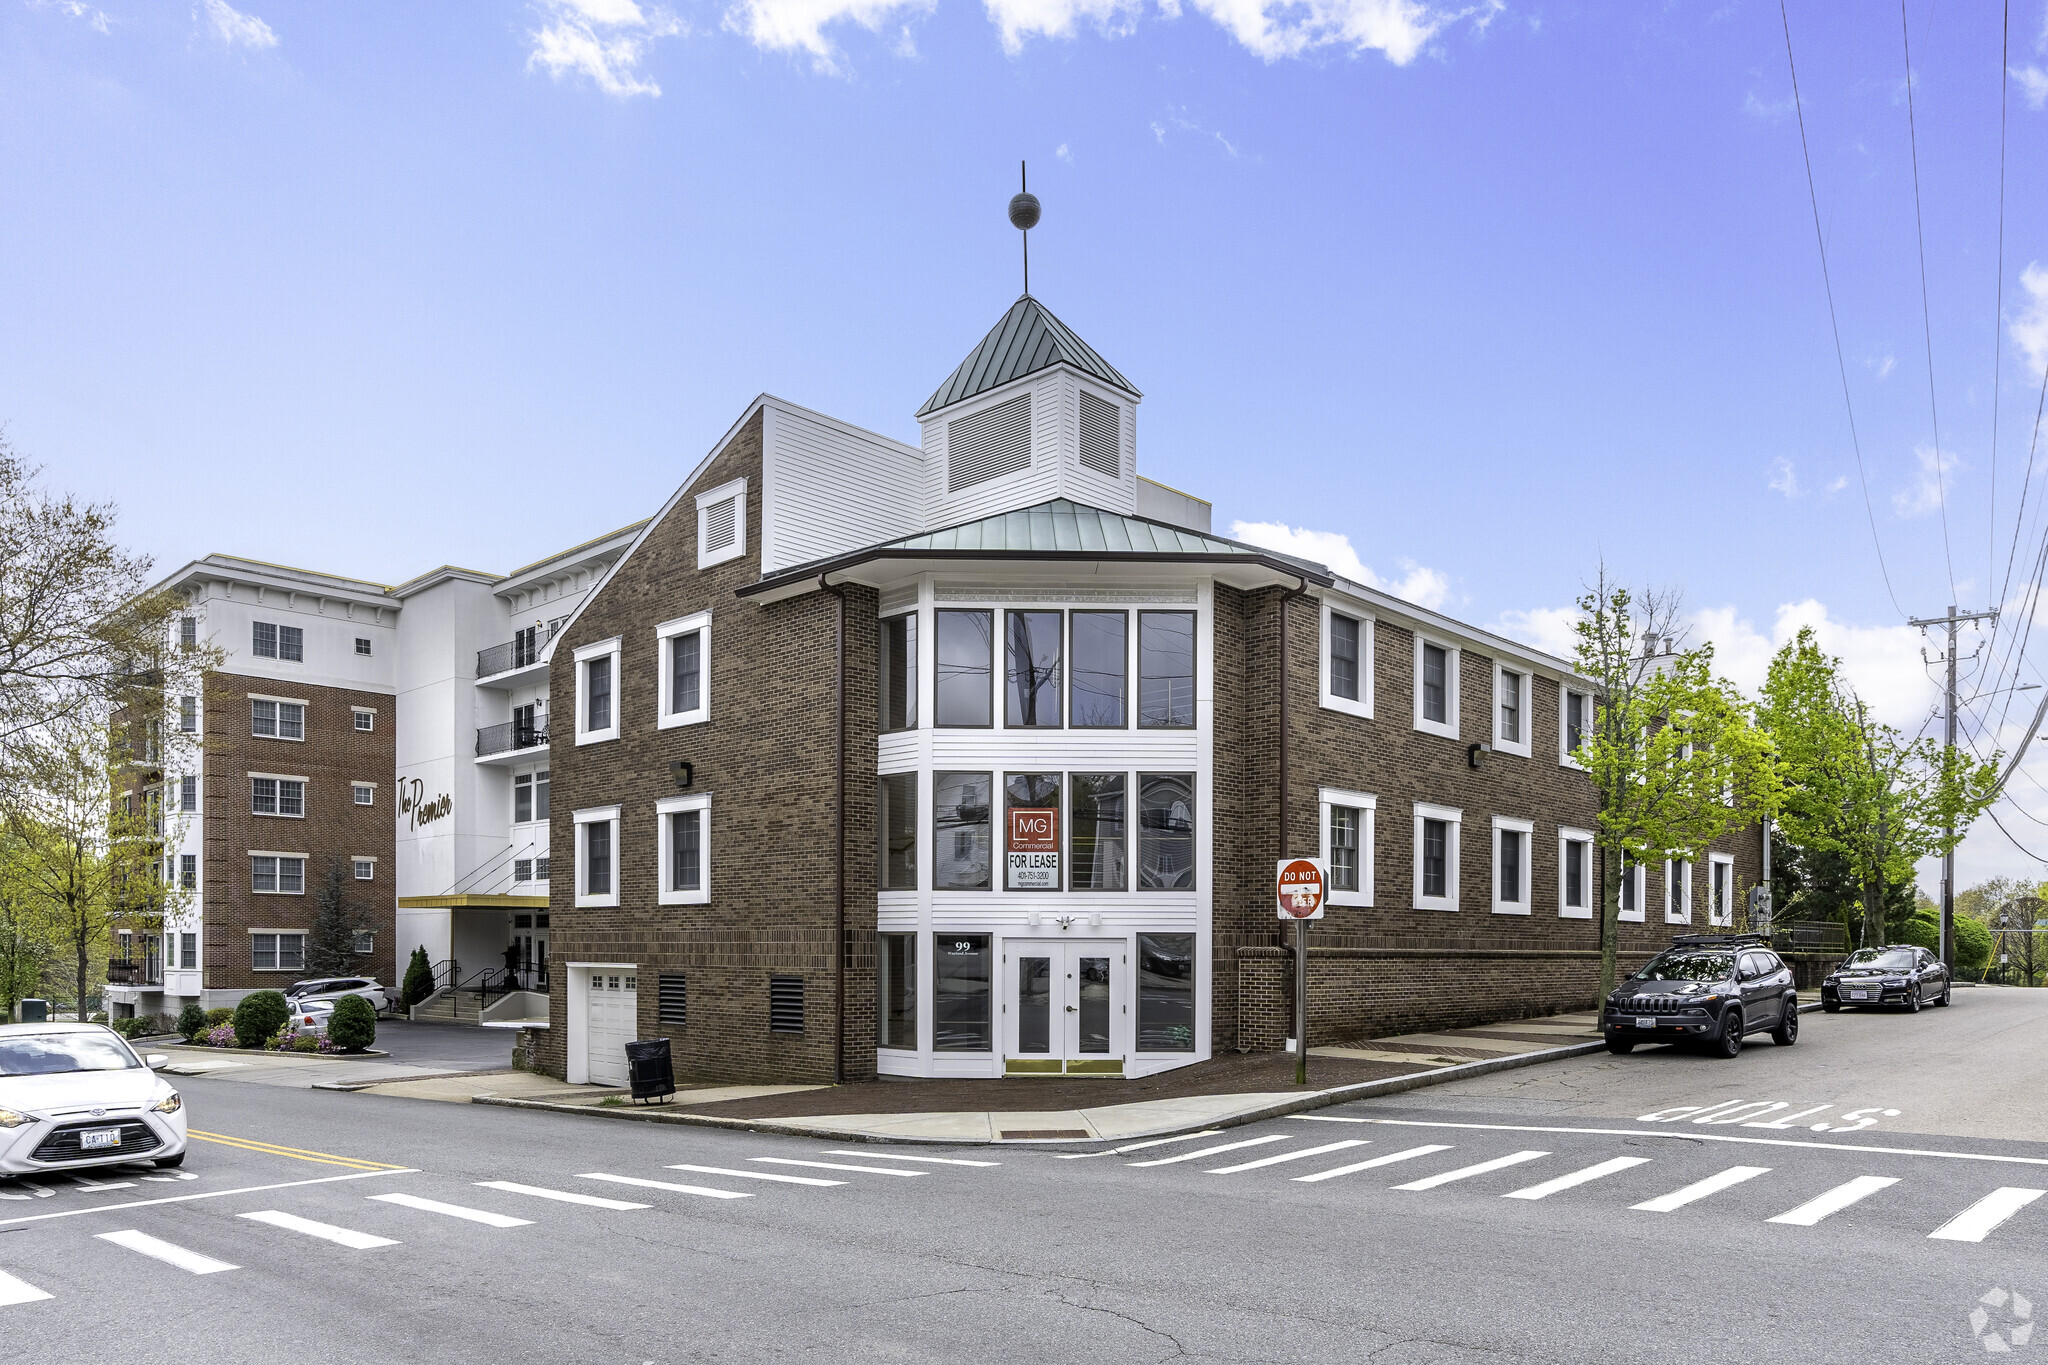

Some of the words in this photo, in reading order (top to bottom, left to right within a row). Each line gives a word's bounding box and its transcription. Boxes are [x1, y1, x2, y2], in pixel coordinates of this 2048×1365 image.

[397, 776, 412, 819] The
[410, 778, 453, 832] Premier
[1019, 818, 1047, 833] MG
[1013, 842, 1054, 850] Commercial
[1009, 855, 1027, 868] FOR
[1029, 855, 1057, 868] LEASE
[1017, 871, 1050, 880] 401-751-3200
[1284, 872, 1296, 881] DO
[1299, 871, 1317, 881] NOT
[955, 941, 970, 952] 99
[1636, 1099, 1902, 1133] STOP
